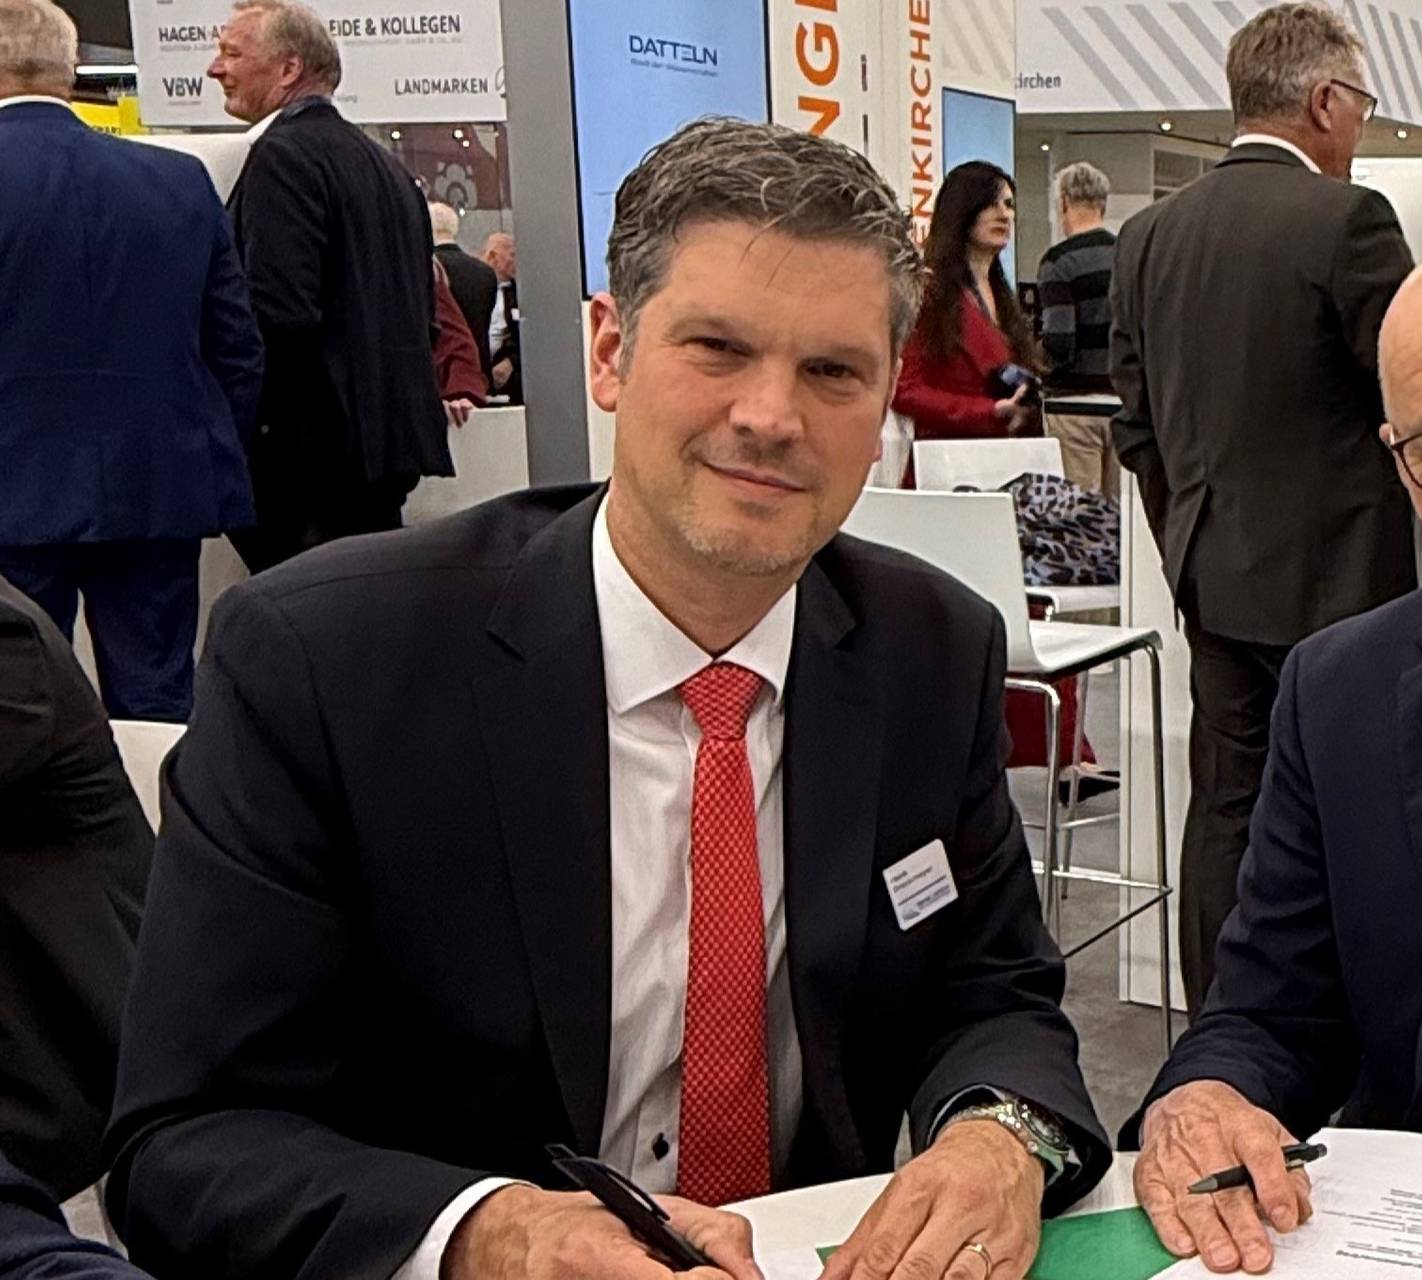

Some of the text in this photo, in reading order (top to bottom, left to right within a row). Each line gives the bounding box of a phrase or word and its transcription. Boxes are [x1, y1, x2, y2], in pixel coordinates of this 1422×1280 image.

[158, 25, 207, 42] HAGEN
[365, 17, 377, 36] &
[381, 14, 462, 35] KOLLEGEN
[629, 34, 719, 67] DATTELN
[162, 76, 203, 98] VBW
[394, 77, 489, 96] LANDMARKEN
